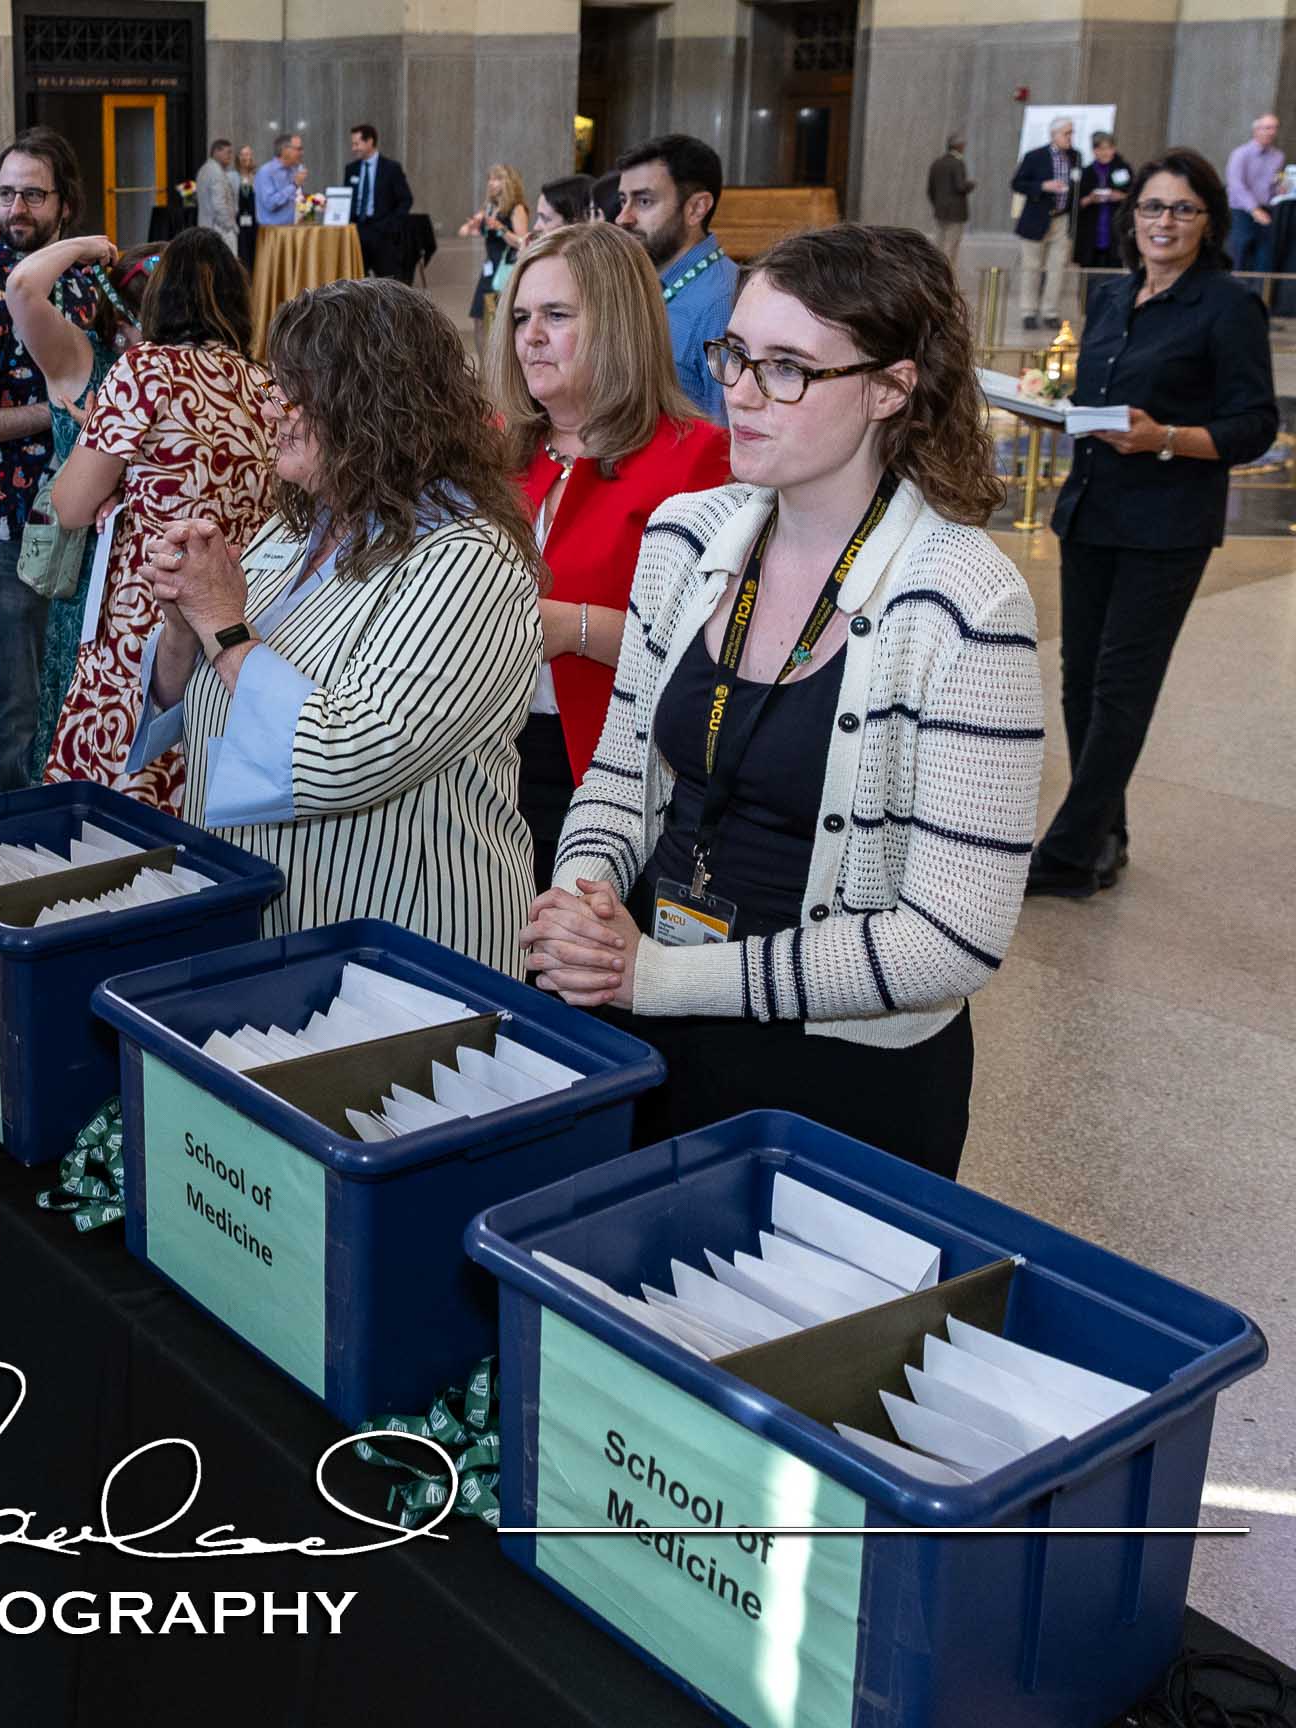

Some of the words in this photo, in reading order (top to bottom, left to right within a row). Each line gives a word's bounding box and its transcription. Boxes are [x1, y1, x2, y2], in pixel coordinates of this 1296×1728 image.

[840, 538, 865, 569] VCU
[735, 593, 755, 625] VCU
[709, 699, 726, 731] VCU
[667, 913, 687, 927] VCU
[185, 1131, 245, 1195] School
[252, 1184, 272, 1212] of
[186, 1182, 273, 1266] Medicine
[604, 1430, 724, 1532] School
[735, 1524, 775, 1565] of
[606, 1488, 762, 1620] Medicine
